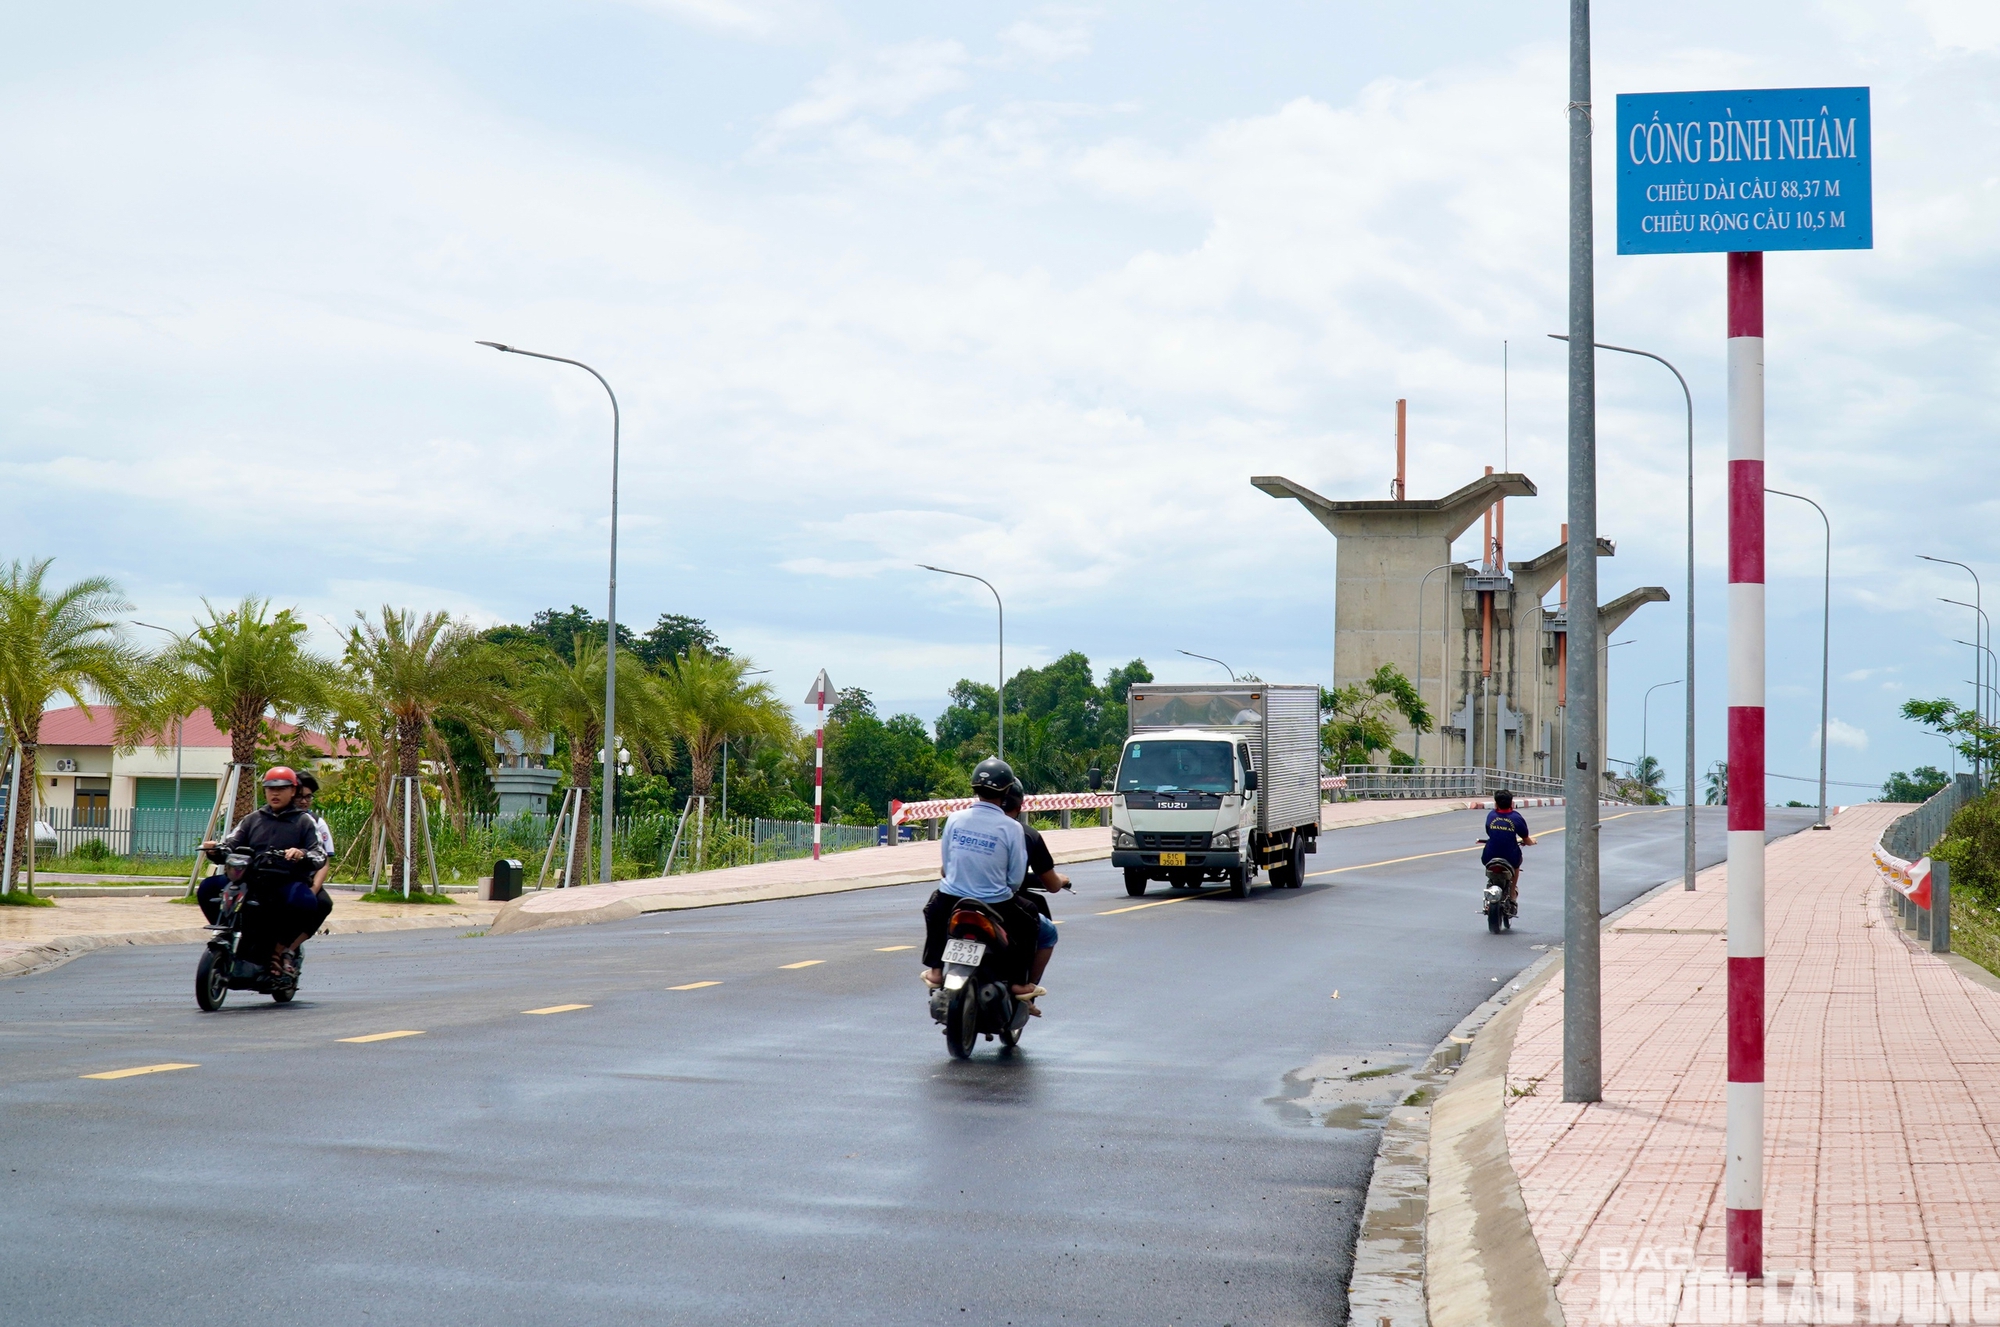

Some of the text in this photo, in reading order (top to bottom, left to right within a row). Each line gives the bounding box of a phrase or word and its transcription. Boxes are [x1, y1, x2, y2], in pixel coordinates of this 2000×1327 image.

[1629, 105, 1857, 165] CỐNG BÌNH NHÂM
[1704, 177, 1735, 201] DÀI
[1781, 180, 1820, 201] 88,37
[1824, 179, 1841, 198] M
[1699, 210, 1749, 235] RỘNG
[1796, 211, 1825, 232] 10,5
[1829, 210, 1846, 228] M
[946, 951, 979, 965] 002.28
[952, 941, 978, 954] 59-S1
